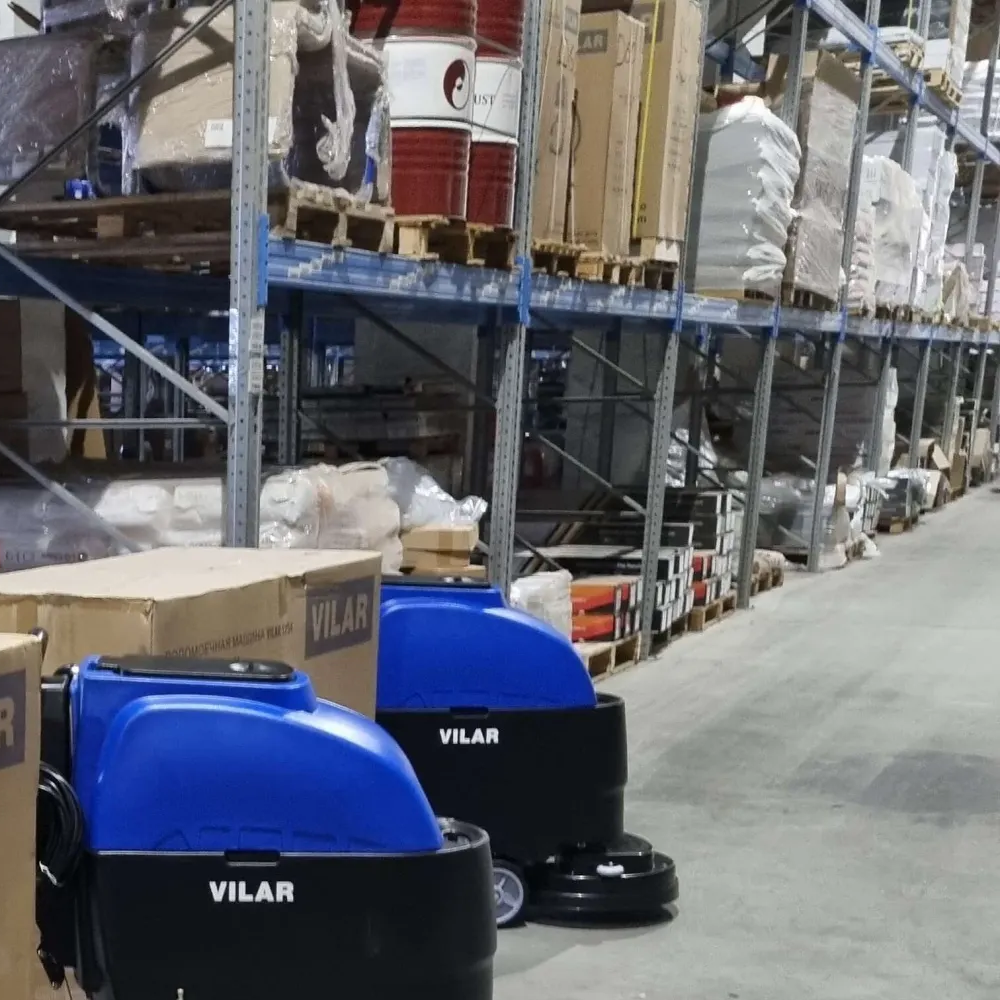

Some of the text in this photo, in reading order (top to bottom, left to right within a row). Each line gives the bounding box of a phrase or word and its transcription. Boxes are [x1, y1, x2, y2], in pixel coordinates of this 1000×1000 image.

[311, 593, 368, 641] VILAR
[439, 728, 499, 744] VILAR
[209, 880, 294, 902] VILAR
